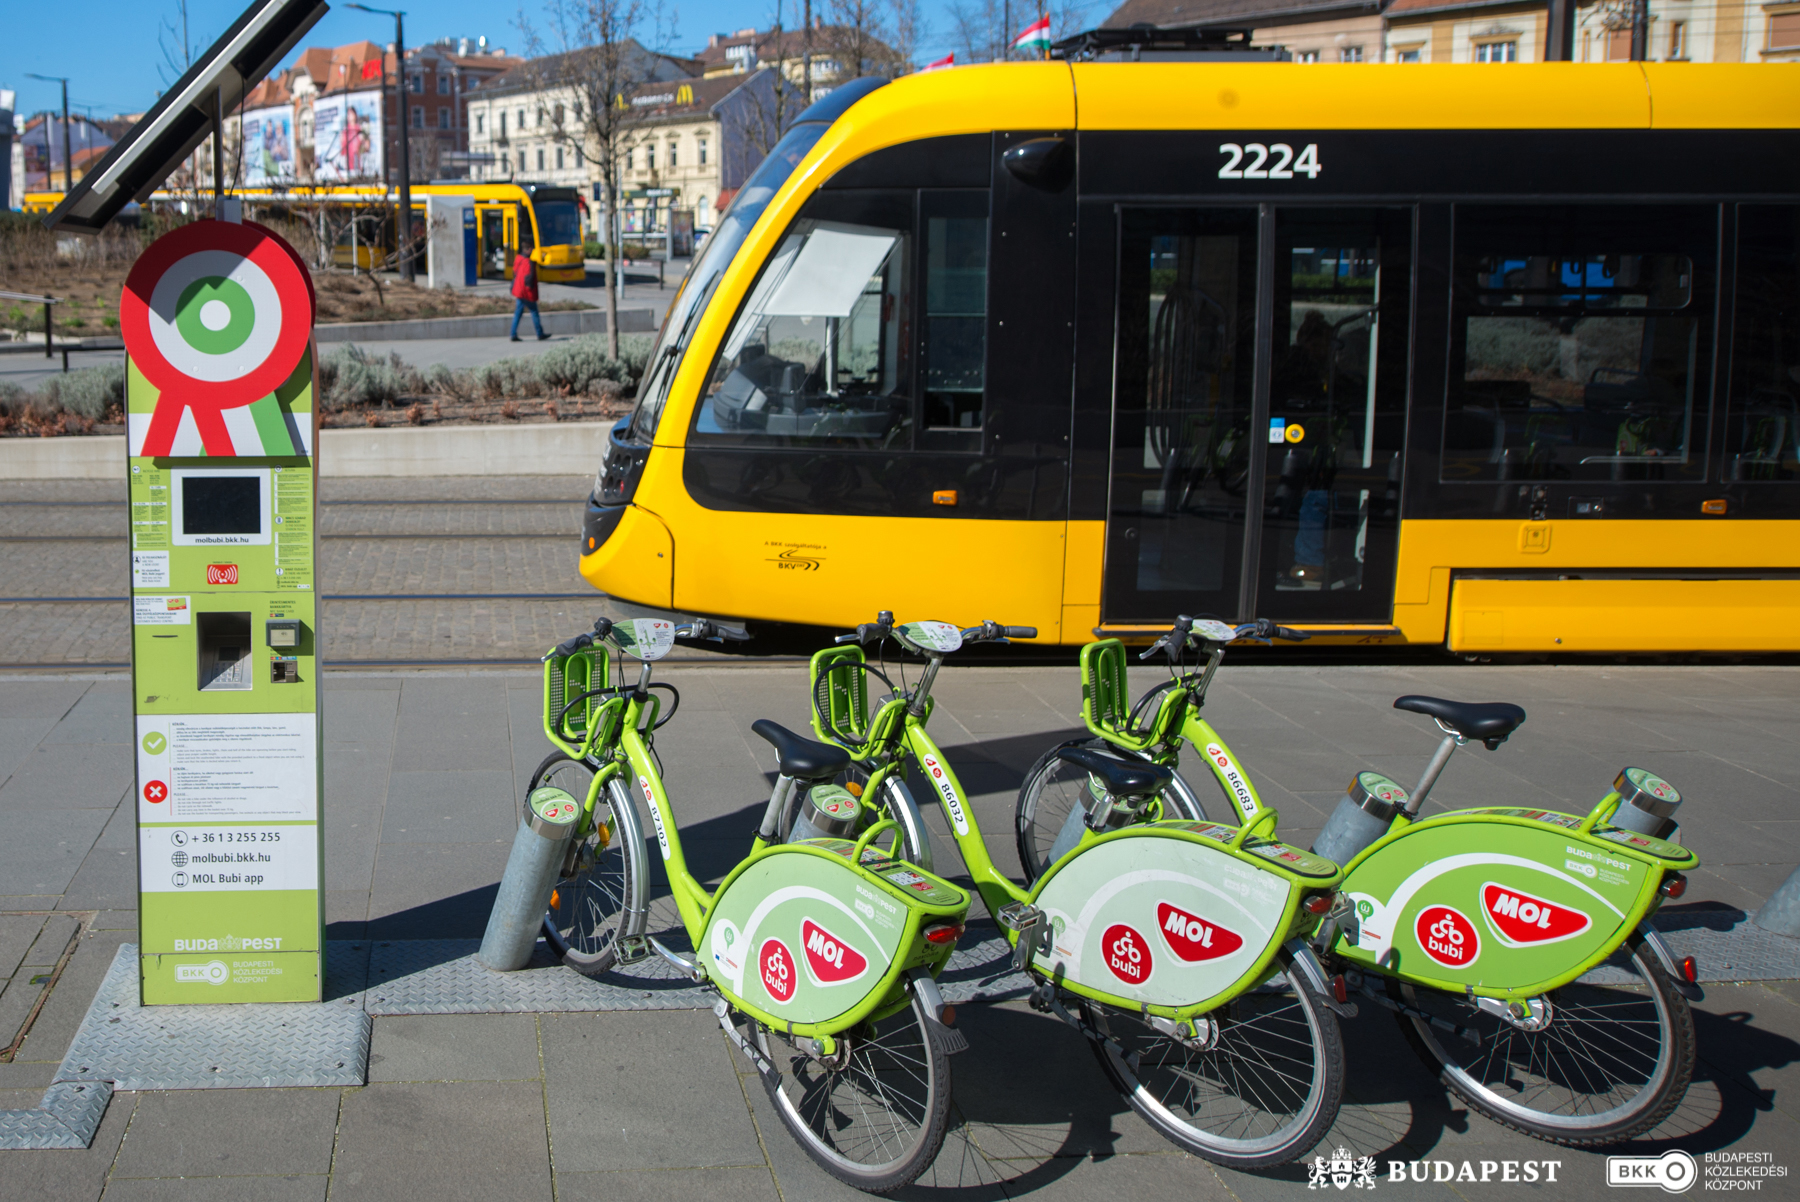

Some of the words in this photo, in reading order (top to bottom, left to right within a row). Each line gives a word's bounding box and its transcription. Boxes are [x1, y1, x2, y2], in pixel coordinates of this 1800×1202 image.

[1218, 143, 1322, 179] 2224
[942, 784, 964, 823] 86032
[1228, 772, 1254, 811] 86683
[202, 833, 215, 842] 36
[218, 833, 223, 842] 1
[227, 833, 233, 842] 3
[236, 833, 256, 842] 255
[260, 832, 280, 842] 255
[650, 806, 667, 848] 87302
[192, 853, 271, 863] molbubi.bkk.hu
[192, 874, 215, 883] MOL
[219, 873, 241, 883] Bubi
[244, 874, 264, 885] app
[1361, 902, 1370, 913] ÚJ
[1492, 892, 1552, 929] MOL
[1164, 910, 1213, 948] MOL
[806, 929, 845, 970] MOL
[1428, 939, 1464, 960] bubi
[1111, 954, 1140, 978] bubi
[765, 970, 787, 996] bubi
